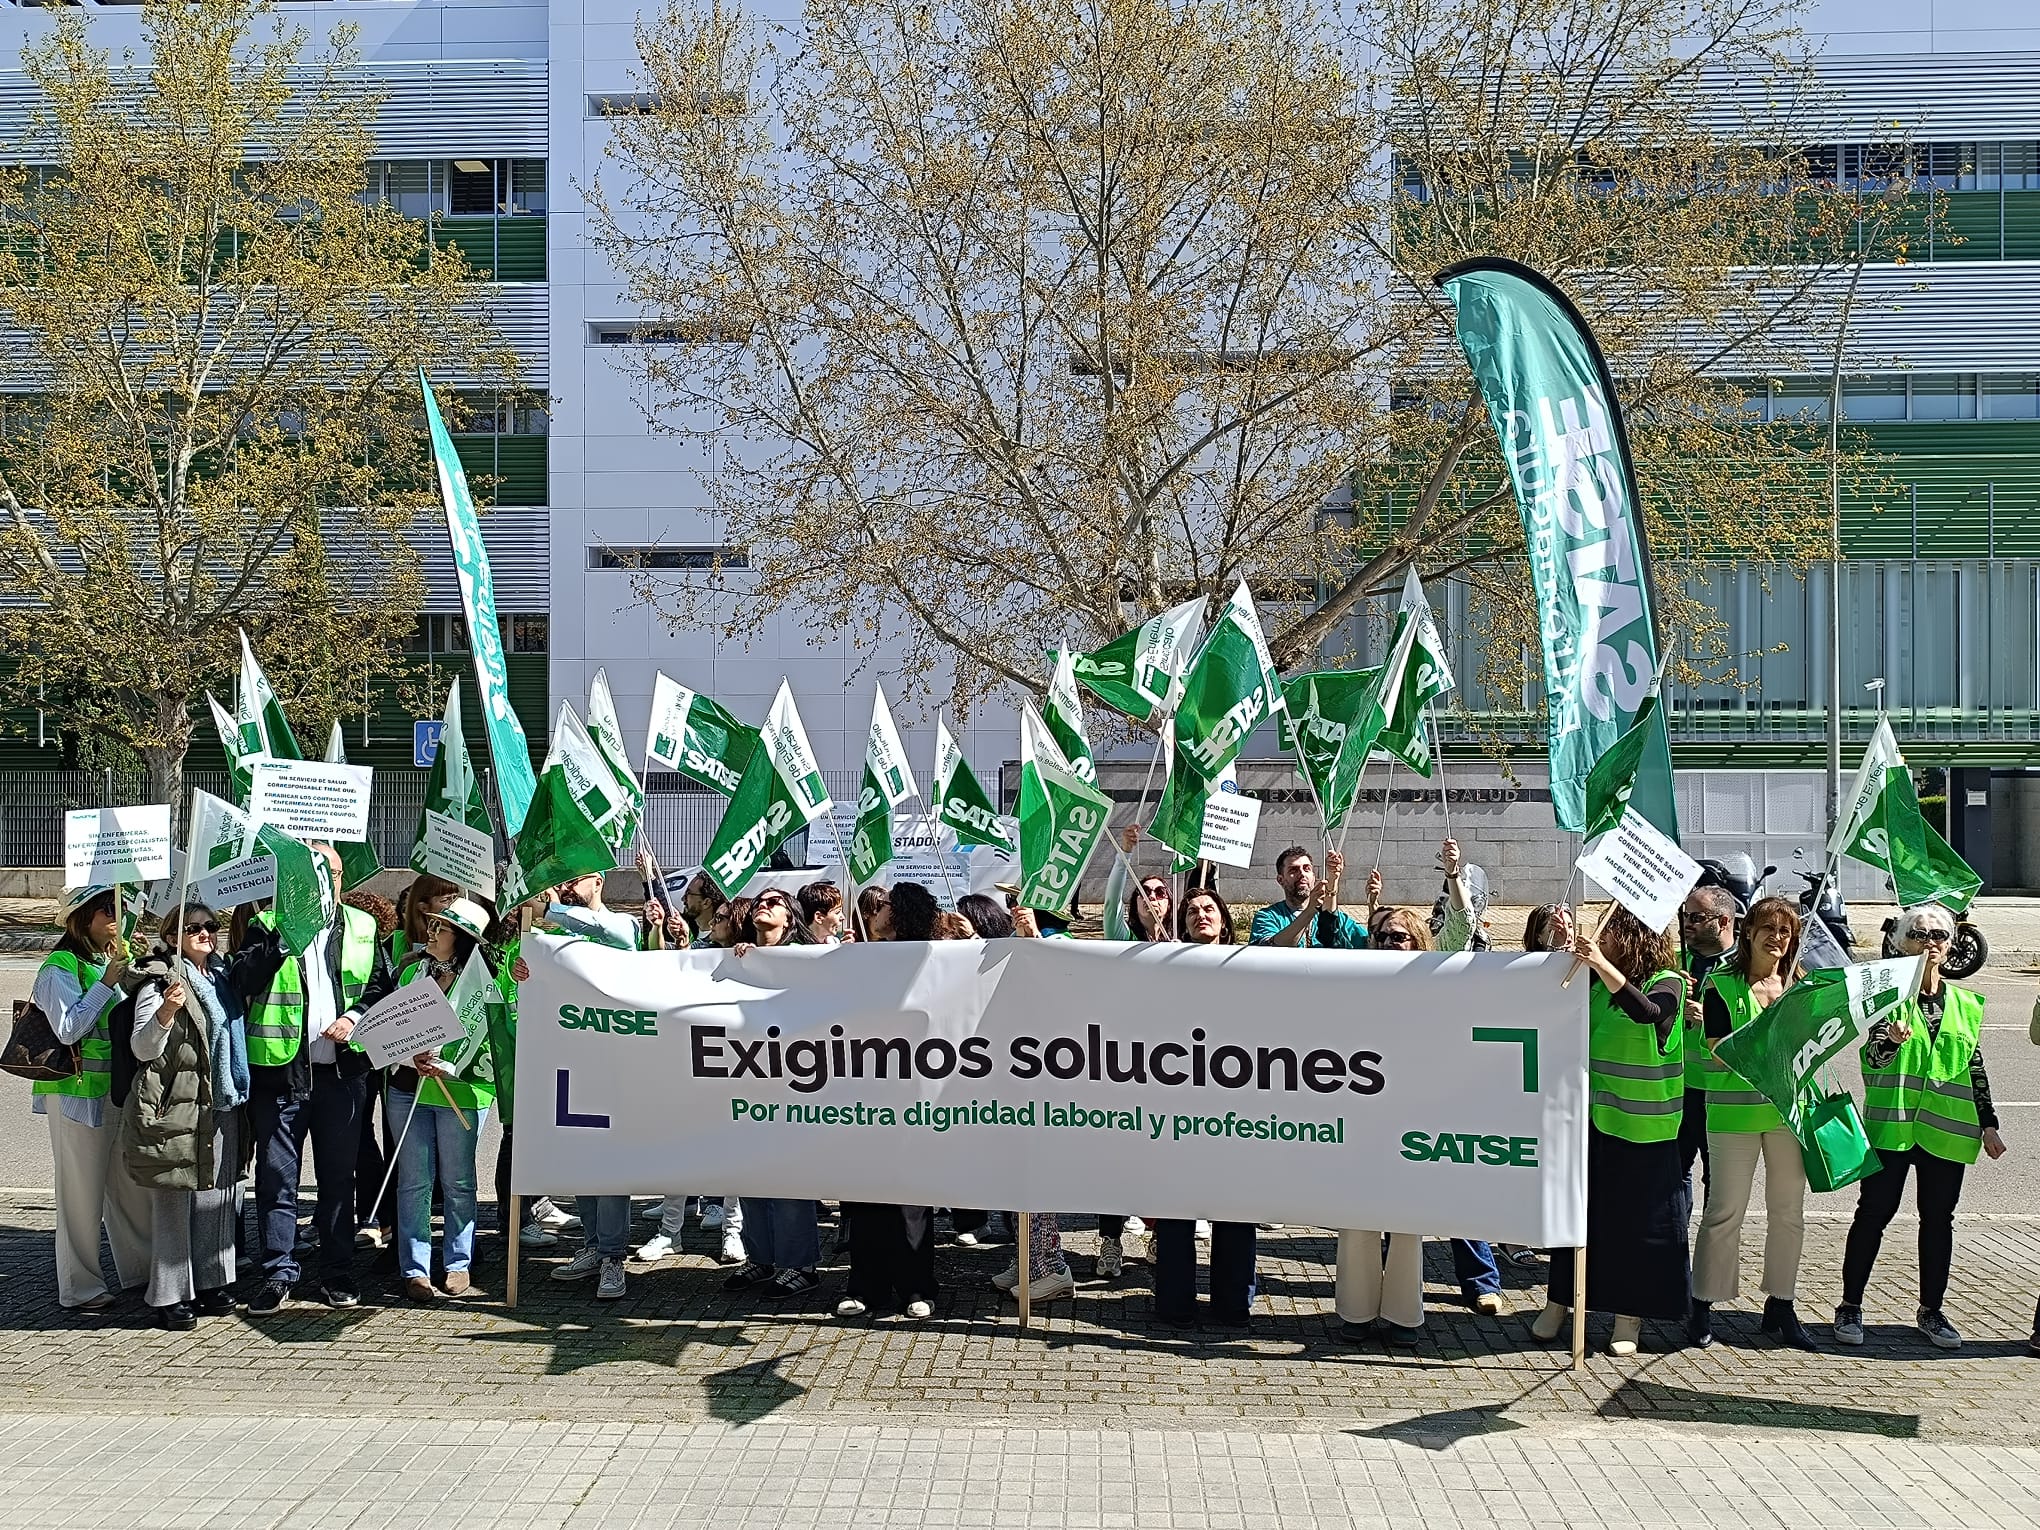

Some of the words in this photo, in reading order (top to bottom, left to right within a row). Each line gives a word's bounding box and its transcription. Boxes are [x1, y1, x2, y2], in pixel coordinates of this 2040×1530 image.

[685, 751, 742, 792] SATSE
[267, 782, 322, 791] CORRESPONSABLE
[1413, 789, 1437, 801] DE
[1447, 789, 1520, 801] SALUD
[1230, 809, 1249, 818] SALUD
[287, 824, 334, 833] CONTRATOS
[442, 829, 463, 842] SERVICIO
[464, 838, 470, 846] DE
[471, 841, 486, 852] SALUD
[68, 840, 116, 849] ENFERMEROS
[117, 837, 168, 846] ESPECIALISTAS
[452, 850, 465, 860] TIENE
[1628, 828, 1655, 855] SERVICIO
[1655, 853, 1664, 862] DE
[1664, 860, 1684, 880] SALUD
[102, 857, 132, 865] SANIDAD
[242, 866, 269, 876] CALIDAD
[446, 862, 453, 870] DE
[454, 866, 475, 878] TRABAJO
[450, 856, 474, 871] NUESTROS
[475, 866, 494, 880] TURNOS
[1618, 836, 1672, 882] CORRESPONSABLE
[1623, 852, 1642, 870] TIENE
[1604, 856, 1627, 876] HACER
[1626, 872, 1658, 902] PLANILLAS
[1612, 876, 1641, 900] ANUALES
[360, 1007, 418, 1036] CORRESPONSABLE
[418, 1000, 438, 1010] TIENE
[368, 1006, 398, 1024] SERVICIO
[409, 992, 430, 1004] SALUD
[459, 990, 484, 1024] ndicato
[558, 1004, 658, 1036] SATSE
[382, 1036, 416, 1050] SUSTITUIR
[388, 1050, 398, 1058] DE
[398, 1046, 410, 1055] LAS
[410, 1033, 446, 1050] AUSENCIAS
[690, 1024, 993, 1094] Exigimos
[1009, 1023, 1385, 1096] soluciones
[731, 1098, 779, 1122] Por
[786, 1101, 896, 1127] nuestra
[903, 1100, 1035, 1133] dignidad
[1044, 1102, 1142, 1132] laboral
[1150, 1112, 1166, 1140] y
[1173, 1112, 1344, 1144] profesional
[1400, 1130, 1538, 1168] SATSE
